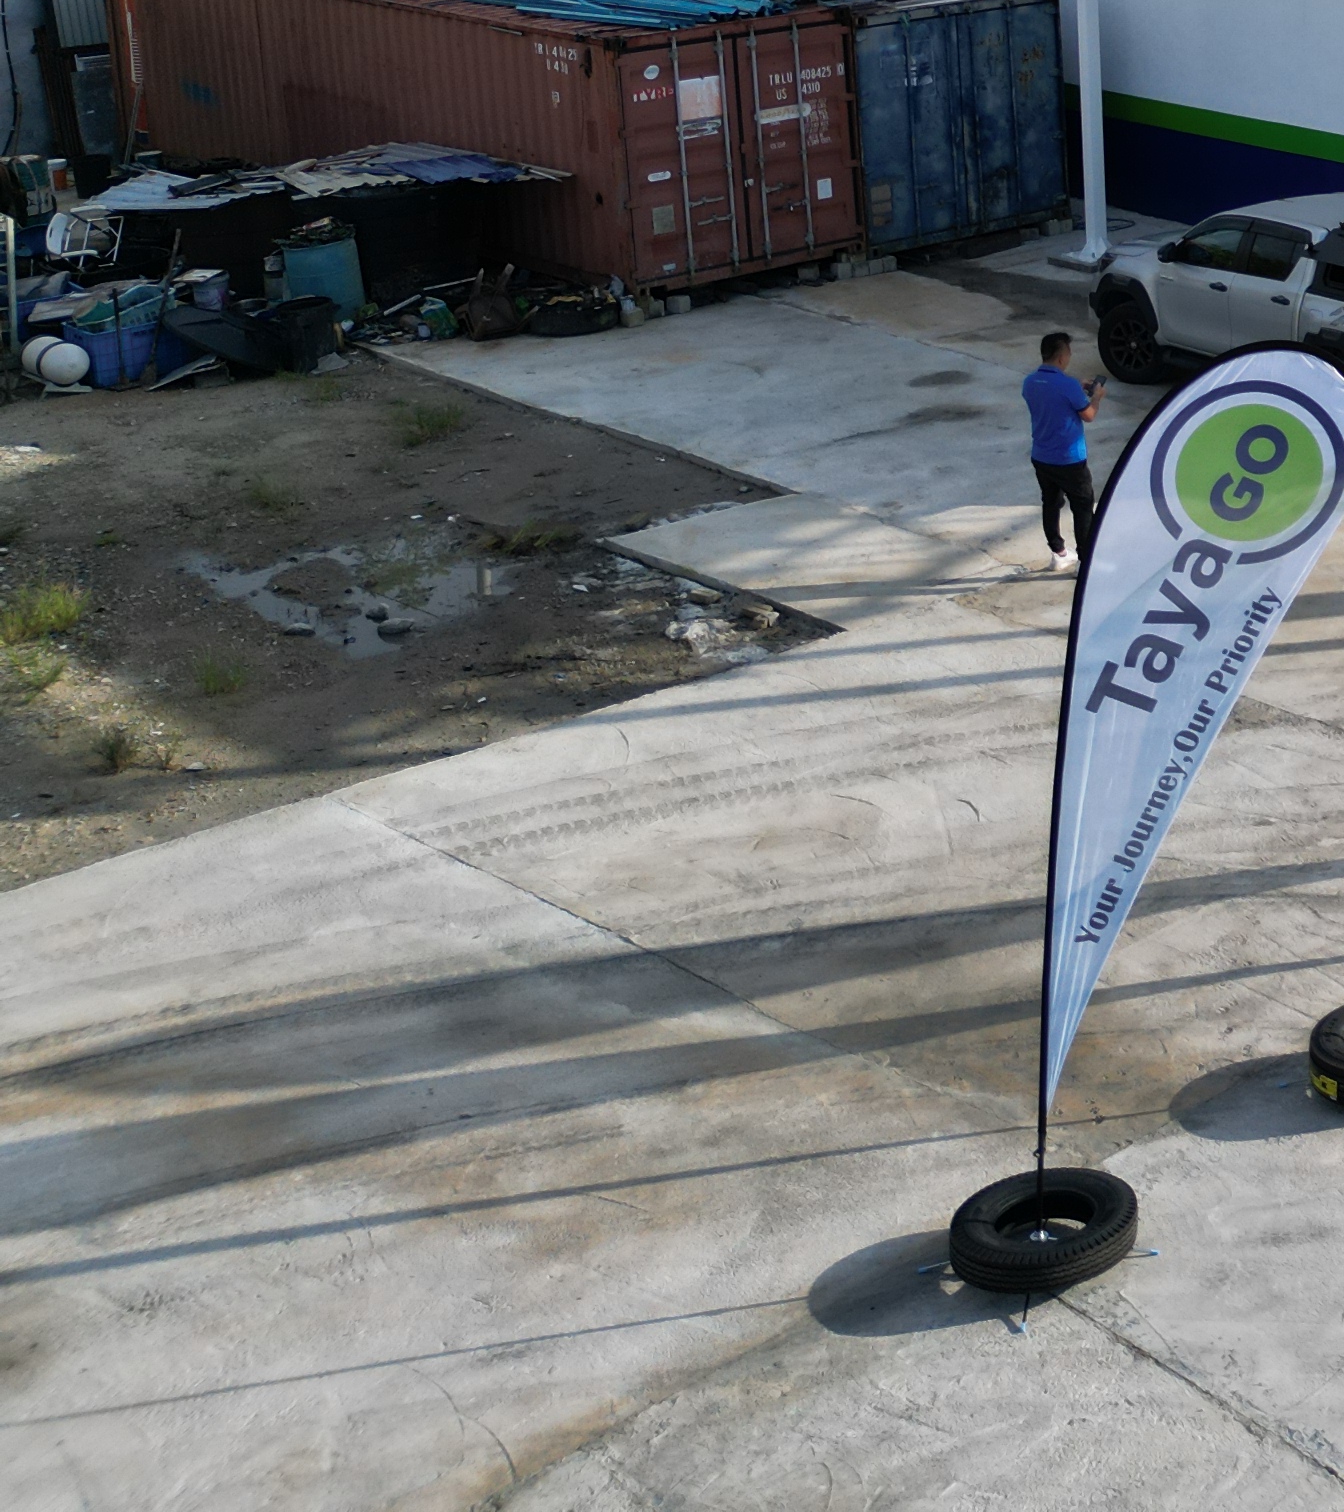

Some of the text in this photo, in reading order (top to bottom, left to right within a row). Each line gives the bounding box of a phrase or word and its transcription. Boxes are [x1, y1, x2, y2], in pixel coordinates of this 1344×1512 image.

[776, 89, 788, 100] US
[1074, 878, 1124, 945] Your
[1204, 586, 1284, 695] Priority
